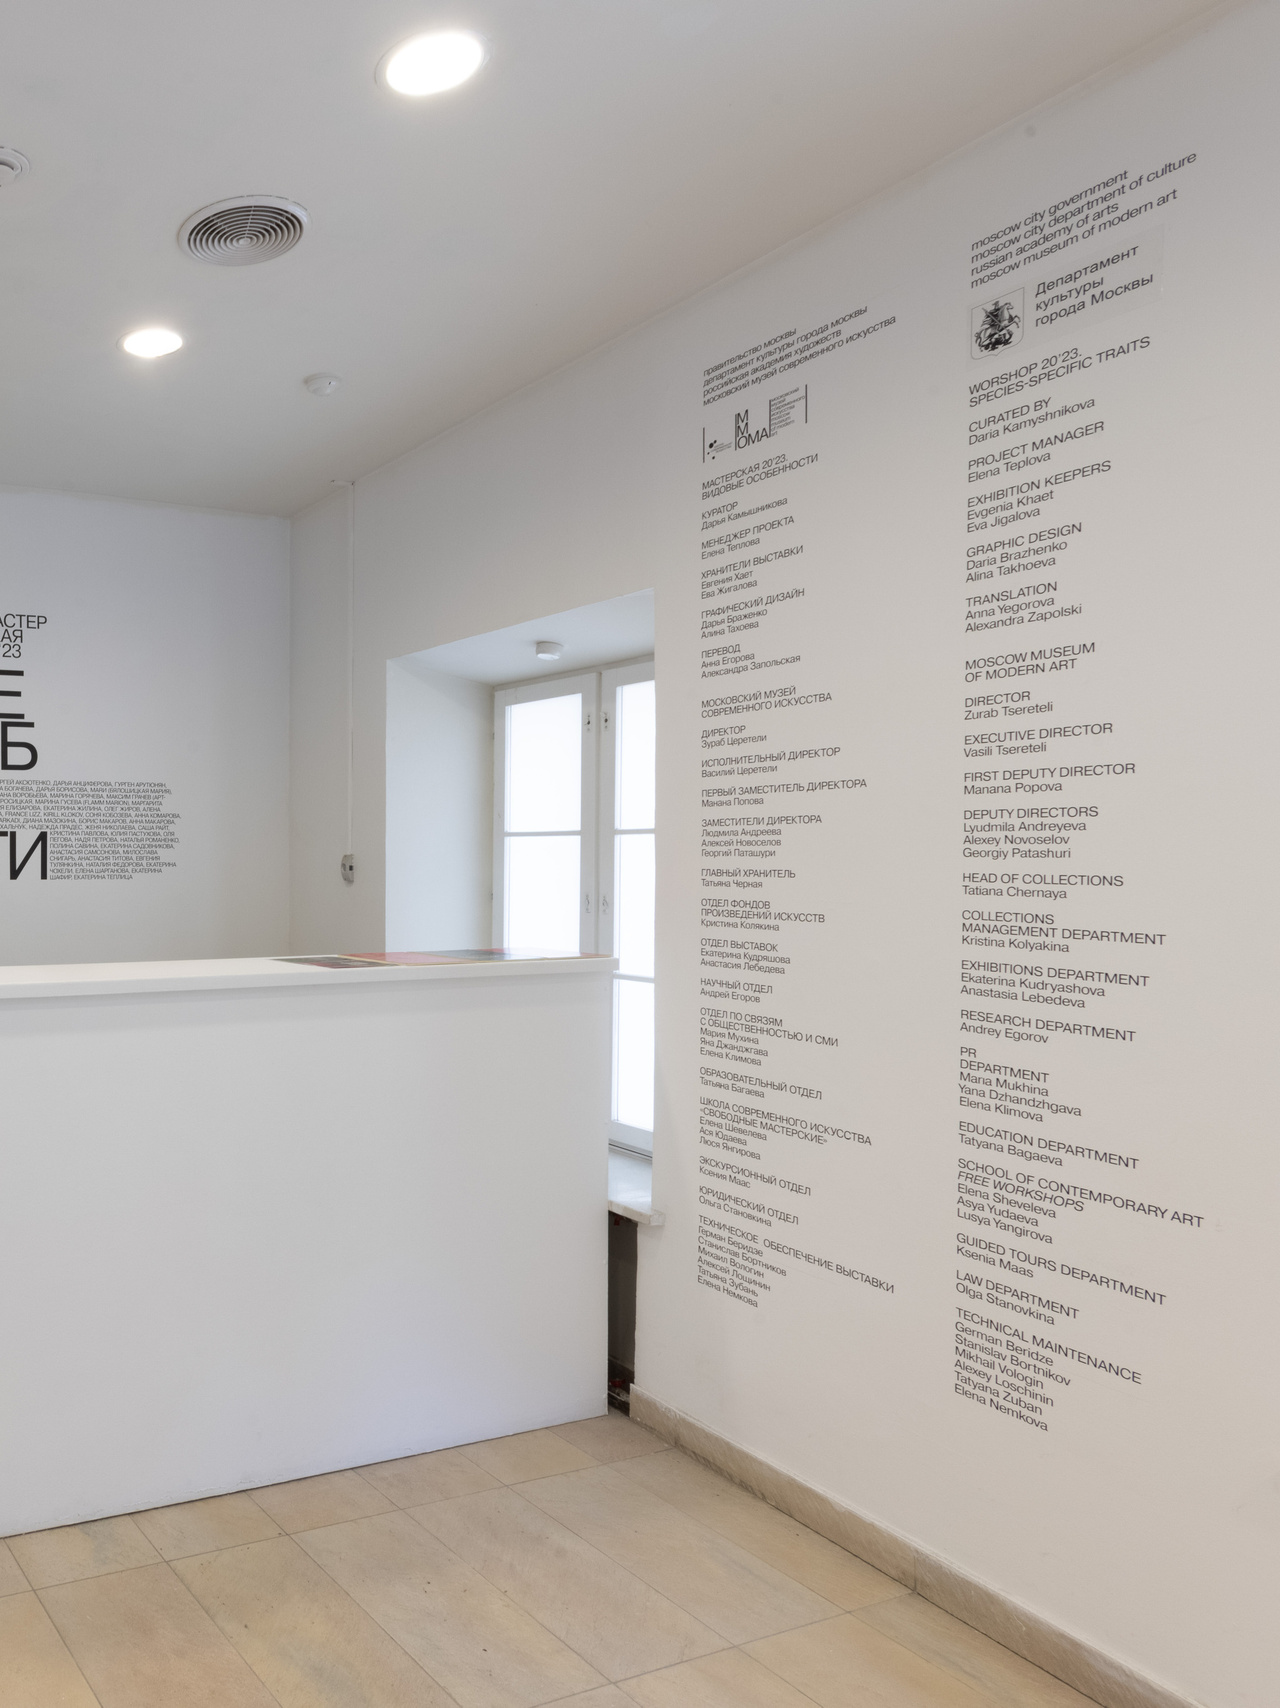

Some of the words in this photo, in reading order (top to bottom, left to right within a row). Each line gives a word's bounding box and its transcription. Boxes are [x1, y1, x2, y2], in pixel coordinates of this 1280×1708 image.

[971, 234, 1021, 263] moscow
[1023, 222, 1045, 239] city
[1048, 184, 1125, 227] department
[1129, 174, 1143, 190] of
[1146, 153, 1196, 182] culture
[971, 221, 1021, 251] moscow
[1023, 209, 1045, 226] city
[1048, 170, 1128, 217] government
[971, 260, 1021, 288] moscow
[1023, 234, 1078, 265] museum
[1081, 224, 1095, 239] of
[1098, 201, 1152, 232] modern
[1156, 188, 1177, 206] art
[971, 251, 1012, 276] russian
[1015, 223, 1073, 256] academy
[1076, 213, 1089, 228] of
[1092, 203, 1118, 221] arts
[1035, 245, 1138, 298] Департамент
[1035, 276, 1103, 311] культуры
[1035, 300, 1085, 327] города
[1091, 274, 1153, 305] Москвы
[702, 357, 754, 388] департамент
[756, 339, 794, 362] культуры
[796, 323, 828, 344] города
[830, 305, 867, 328] москвы
[703, 344, 762, 376] правительство
[763, 328, 796, 348] москвы
[703, 379, 749, 406] московский
[751, 366, 777, 385] музей
[778, 339, 844, 373] современного
[845, 316, 896, 344] искусства
[968, 362, 1037, 395] WORSHOP
[969, 356, 1092, 407] SPECIES-SPECIFIC
[1095, 335, 1150, 363] TRAITS
[968, 404, 1030, 432] CURATED
[1033, 396, 1051, 411] BY
[968, 428, 999, 445] Daria
[1003, 398, 1094, 434] Kamyshnikova
[968, 443, 1028, 470] PROJECT
[1031, 420, 1104, 451] MANAGER
[701, 478, 744, 500] ВИДОВЫЕ
[745, 453, 818, 485] ОСОБЕННОСТИ
[702, 462, 759, 490] МАСТЕРСКАЯ
[967, 479, 1040, 508] EXHIBITION
[1044, 460, 1111, 487] KEEPERS
[701, 501, 738, 520] КУРАТОР
[701, 528, 750, 549] МЕНЕДЖЕР
[752, 515, 794, 535] ПРОЕКТА
[966, 535, 1024, 557] GRAPHIC
[1028, 521, 1081, 544] DESIGN
[701, 559, 750, 579] ХРАНИТЕЛИ
[752, 544, 803, 566] ВЫСТАВКИ
[966, 556, 996, 570] Daria
[1000, 541, 1067, 563] Brazhenko
[701, 596, 763, 619] ГРАФИЧЕСКИЙ
[764, 587, 804, 606] ДИЗАЙН
[965, 581, 1057, 607] TRANSLATION
[965, 615, 1024, 633] Alexandra
[1027, 603, 1081, 622] Zapolski
[701, 643, 740, 658] ПЕРЕВОД
[965, 651, 1027, 670] MOSCOW
[1030, 641, 1094, 661] MUSEUM
[964, 670, 982, 682] OF
[985, 662, 1045, 680] MODERN
[1048, 657, 1077, 672] ART
[964, 690, 1030, 707] DIRECTOR
[964, 707, 998, 720] Zurab
[1001, 701, 1052, 716] Tsereteli
[700, 724, 746, 739] ДИРЕКТОР
[964, 729, 1035, 745] EXECUTIVE
[1039, 722, 1112, 739] DIRECTOR
[701, 750, 785, 767] ИСПОЛНИТЕЛЬНЫЙ
[787, 746, 840, 761] ДИРЕКТОР
[964, 770, 999, 782] FIRST
[1002, 767, 1056, 780] DEPUTY
[1059, 762, 1135, 777] DIRECTOR
[701, 786, 736, 797] ПЕРВЫЙ
[738, 782, 804, 795] ЗАМЕСТИТЕЛЬ
[806, 778, 867, 792] ДИРЕКТОРА
[963, 784, 1011, 794] Manana
[1015, 782, 1062, 794] Popova
[963, 808, 1014, 819] DEPUTY
[1016, 805, 1098, 818] DIRECTORS
[963, 821, 1015, 834] Lyudmila
[1018, 821, 1086, 833] Andreyeva
[962, 872, 997, 883] HEAD
[1000, 873, 1019, 883] OF
[1022, 873, 1123, 886] COLLECTIONS
[961, 909, 1054, 925] COLLECTIONS
[700, 937, 728, 948] ОТДЕЛ
[730, 940, 778, 952] ВЫСТАВОК
[962, 922, 1058, 937] MANAGEMENT
[1061, 928, 1166, 945] DEPARTMENT
[700, 977, 740, 990] НАУЧНЫЙ
[742, 982, 772, 994] ОТДЕЛ
[961, 959, 1043, 977] EXHIBITIONS
[1047, 967, 1149, 986] DEPARTMENT
[960, 1009, 1031, 1028] RESEARCH
[1035, 1018, 1136, 1041] DEPARTMENT
[960, 1046, 976, 1058] PR
[699, 1066, 787, 1092] ОБРАЗОВАТЕЛЬНЫЙ
[789, 1084, 822, 1100] ОТДЕЛ
[960, 1058, 1049, 1083] DEPARTMENT
[959, 1120, 1033, 1146] EDUCATION
[1037, 1137, 1139, 1169] DEPARTMENT
[957, 1170, 990, 1187] FREE
[993, 1179, 1084, 1211] WORKSHOPS
[957, 1157, 1012, 1181] SCHOOL
[1015, 1172, 1034, 1184] OF
[1037, 1177, 1168, 1218] CONTEMPORARY
[1170, 1210, 1204, 1227] ART
[698, 1214, 758, 1244] ТЕХНИЧЕСКОЕ
[763, 1238, 833, 1271] ОБЕСПЕЧЕНИЕ
[835, 1263, 894, 1293] ВЫСТАВКИ
[956, 1232, 1005, 1255] GUIDED
[1008, 1247, 1056, 1271] TOURS
[1060, 1263, 1166, 1305] DEPARTMENT
[956, 1269, 983, 1286] LAW
[985, 1279, 1079, 1319] DEPARTMENT
[955, 1306, 1028, 1343] TECHNICAL
[1032, 1334, 1141, 1384] MAINTENANCE
